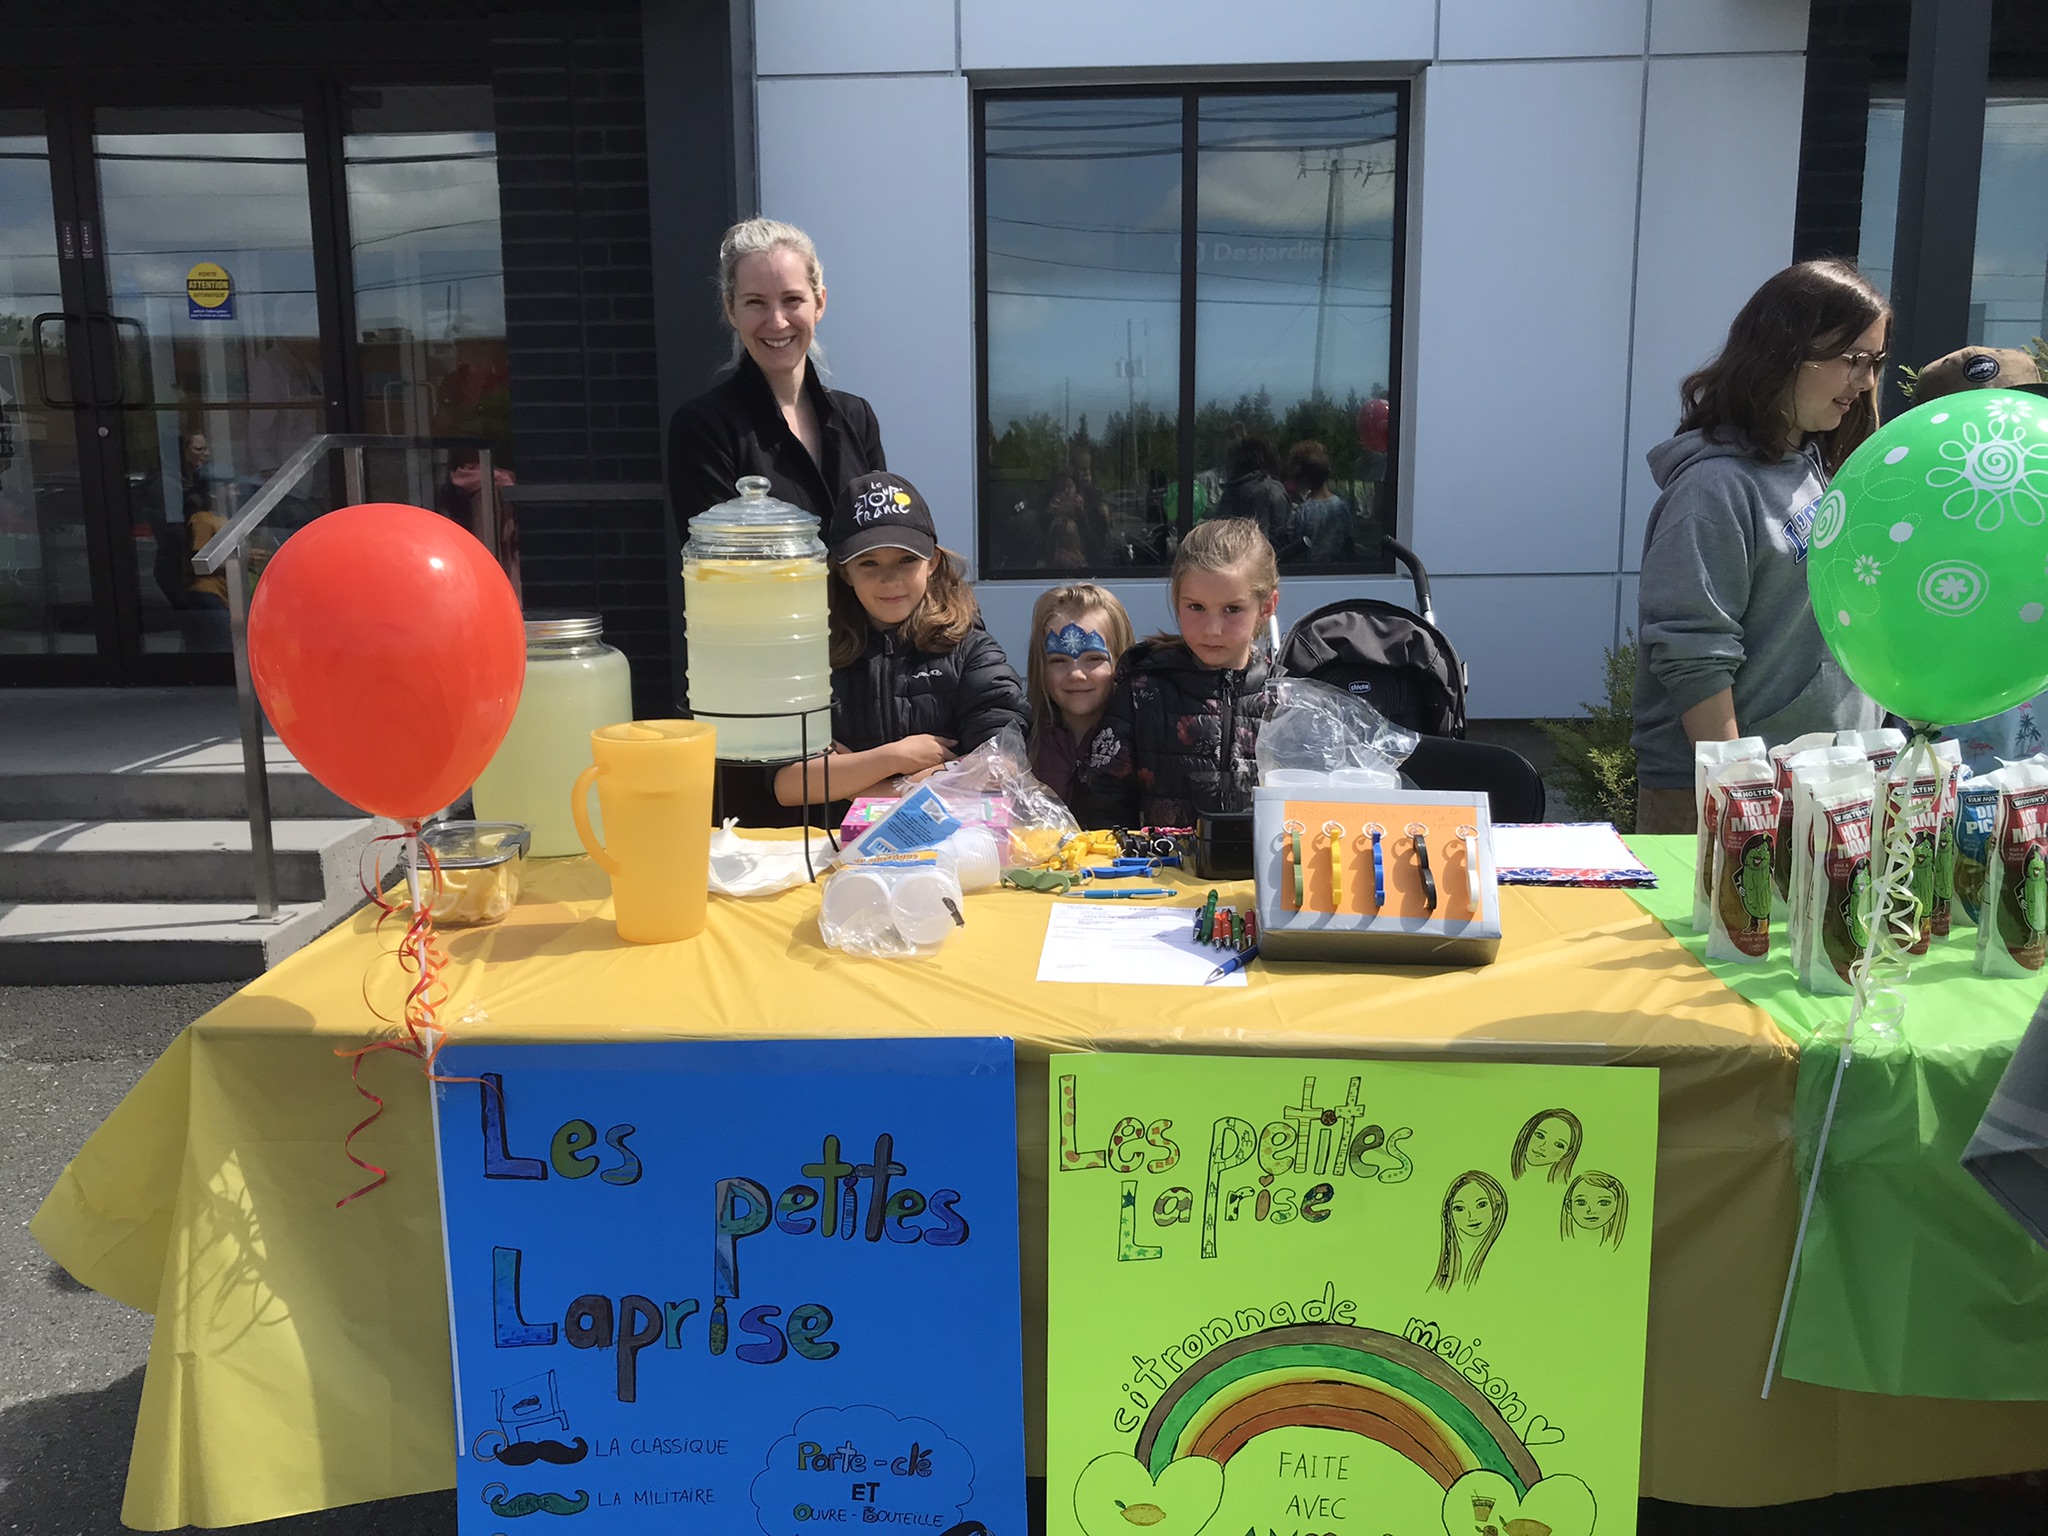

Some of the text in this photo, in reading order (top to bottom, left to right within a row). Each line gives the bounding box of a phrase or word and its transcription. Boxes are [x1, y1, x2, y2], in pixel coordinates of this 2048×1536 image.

[1213, 240, 1334, 266] Desjardin
[188, 280, 229, 290] ATTENTION
[1742, 788, 1774, 798] HOLTEN
[1982, 794, 1999, 803] HOLT
[1741, 800, 1772, 817] HOT
[2020, 808, 2038, 827] HOT
[1841, 821, 1868, 840] HOT
[1965, 819, 1993, 834] PIC
[1837, 836, 1871, 859] MAM
[480, 1072, 643, 1186] Les
[1058, 1074, 1414, 1260] Les petites
[714, 1133, 970, 1299] petites
[492, 1246, 840, 1402] Laprise
[1113, 1280, 1357, 1434] citronnade
[1403, 1316, 1529, 1425] maison
[595, 1439, 621, 1457] LA
[1278, 1451, 1350, 1480] FAITE
[598, 1491, 621, 1507] LA
[851, 1482, 881, 1503] ET
[1285, 1494, 1347, 1520] AVEC
